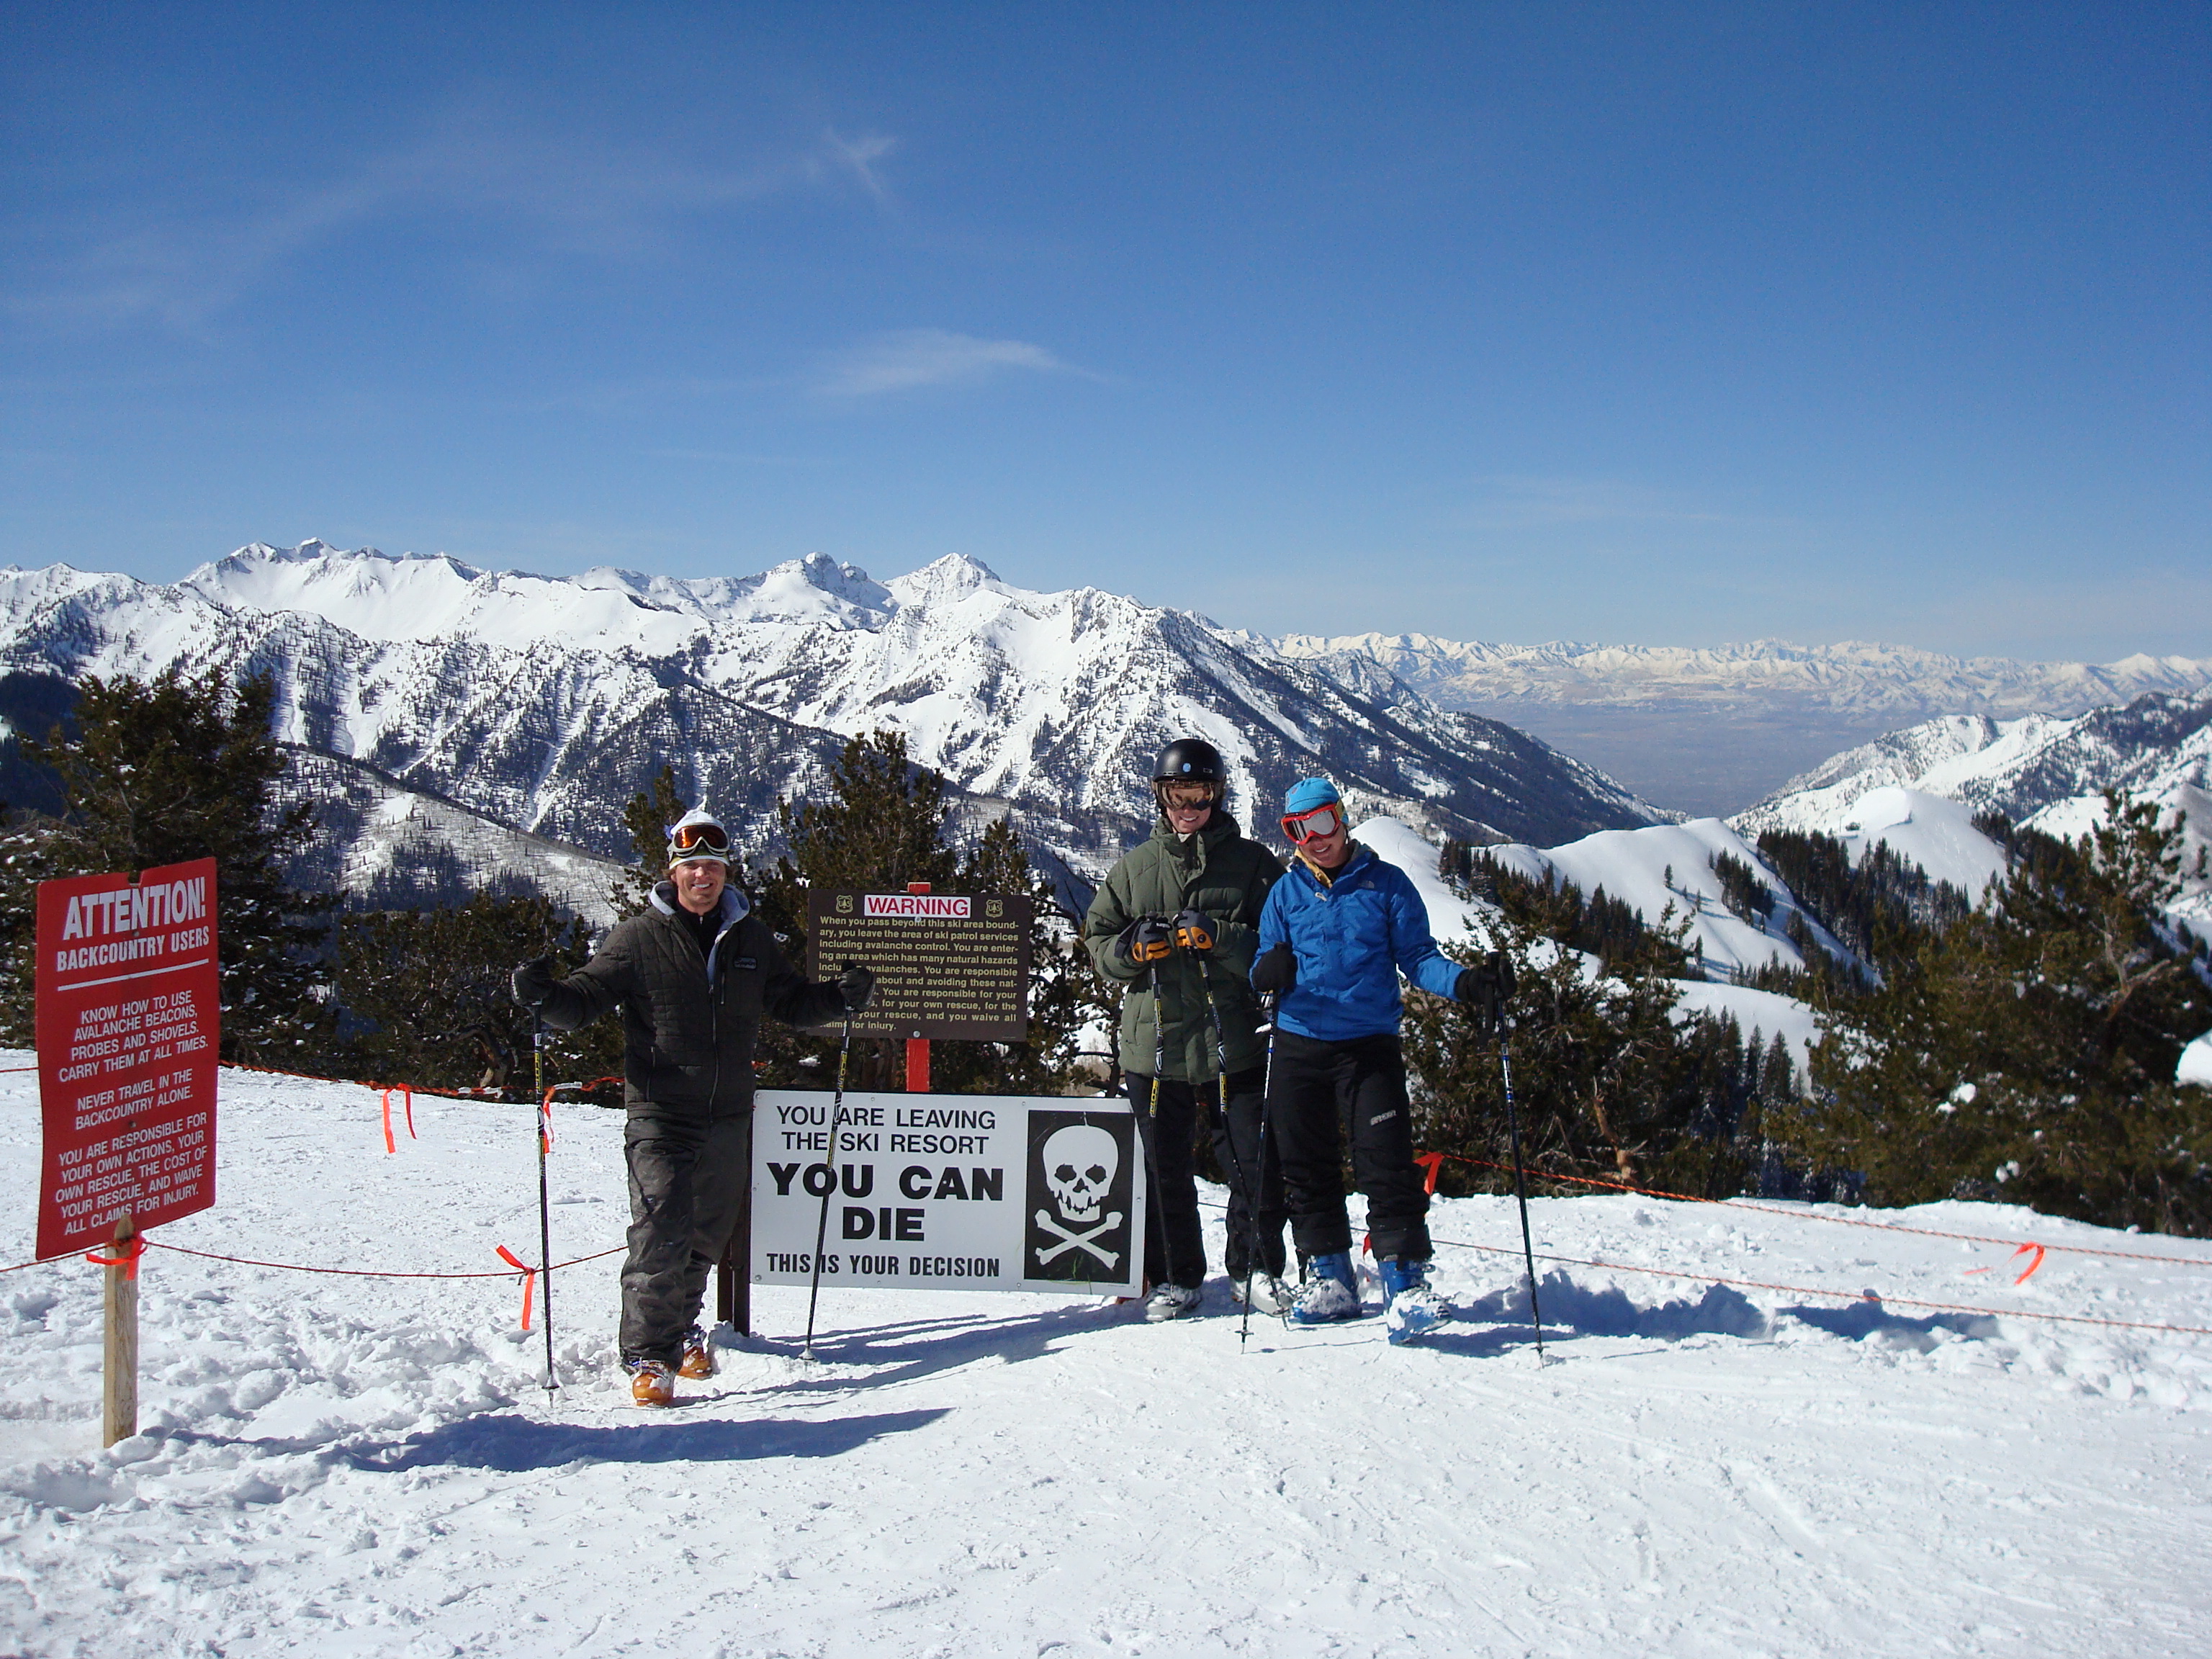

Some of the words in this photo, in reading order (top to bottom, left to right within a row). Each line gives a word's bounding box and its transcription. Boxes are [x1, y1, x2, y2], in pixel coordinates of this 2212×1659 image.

[63, 877, 206, 940] ATTENTION!
[820, 916, 847, 925] When
[848, 918, 866, 927] you
[892, 918, 926, 927] beyond
[928, 919, 945, 927] this
[986, 920, 1019, 929] bound-
[868, 897, 968, 915] WARNING
[57, 935, 165, 972] BACKCOUNTRY
[171, 925, 210, 953] USERS
[819, 929, 837, 938] ary,
[858, 929, 883, 938] leave
[950, 932, 978, 940] patrol
[819, 939, 863, 950] including
[866, 940, 913, 950] avalanche
[819, 950, 834, 961] ing
[871, 953, 899, 961] which
[920, 956, 945, 964] many
[947, 955, 979, 963] natural
[981, 955, 1018, 964] hazards
[963, 968, 1017, 976] responsible
[906, 976, 923, 985] and
[927, 978, 966, 988] avoiding
[999, 979, 1017, 988] nat-
[922, 989, 976, 998] responsible
[74, 1016, 141, 1042] AVALANCHE
[145, 1004, 197, 1027] BEACONS,
[81, 1004, 118, 1024] KNOW
[122, 999, 149, 1017] HOW
[153, 995, 167, 1009] TO
[171, 989, 192, 1007] USE
[858, 1011, 880, 1020] your
[885, 1012, 922, 1020] rescue,
[949, 1014, 966, 1022] you
[947, 1002, 981, 1011] rescue,
[1002, 1002, 1017, 1011] the
[71, 1038, 120, 1061] PROBES
[124, 1033, 146, 1050] AND
[150, 1021, 199, 1043] SHOVELS.
[868, 1021, 896, 1031] injury.
[59, 1061, 99, 1083] CARRY
[104, 1053, 135, 1073] THEM
[138, 1048, 151, 1064] AT
[154, 1044, 173, 1060] ALL
[176, 1035, 208, 1054] TIMES.
[76, 1090, 115, 1112] NEVER
[118, 1079, 156, 1100] TRAVEL
[159, 1074, 170, 1089] IN
[173, 1069, 193, 1084] THE
[76, 1096, 154, 1130] BACKCOUNTRY
[157, 1086, 193, 1106] ALONE.
[1149, 1079, 1159, 1116] SCOTT
[776, 1105, 825, 1125] YOU
[839, 1107, 884, 1126] ARE
[896, 1109, 996, 1129] LEAVING
[59, 1148, 82, 1166] YOU
[86, 1141, 108, 1159] ARE
[112, 1119, 184, 1151] RESPONSIBLE
[187, 1112, 207, 1129] FOR
[61, 1164, 92, 1184] YOUR
[96, 1154, 122, 1174] OWN
[179, 1129, 204, 1149] YOUR
[781, 1132, 828, 1151] THE
[840, 1133, 878, 1151] SKI
[891, 1133, 989, 1154] RESORT
[55, 1184, 84, 1202] OWN
[88, 1169, 135, 1194] RESCUE,
[139, 1161, 160, 1178] THE
[164, 1151, 192, 1171] COST
[194, 1145, 207, 1161] OF
[61, 1198, 92, 1218] YOUR
[97, 1183, 144, 1209] RESCUE,
[149, 1175, 170, 1194] AND
[174, 1164, 203, 1184] WAIVE
[766, 1162, 873, 1198] YOU
[899, 1165, 1004, 1201] CAN
[64, 1218, 86, 1236] ALL
[91, 1203, 132, 1228] CLAIMS
[137, 1195, 160, 1214] FOR
[164, 1182, 199, 1205] INJURY.
[842, 1206, 925, 1241] DIE
[766, 1253, 811, 1273] THIS
[821, 1254, 840, 1273] IS
[850, 1255, 899, 1274] YOUR
[909, 1256, 999, 1277] DECISION
